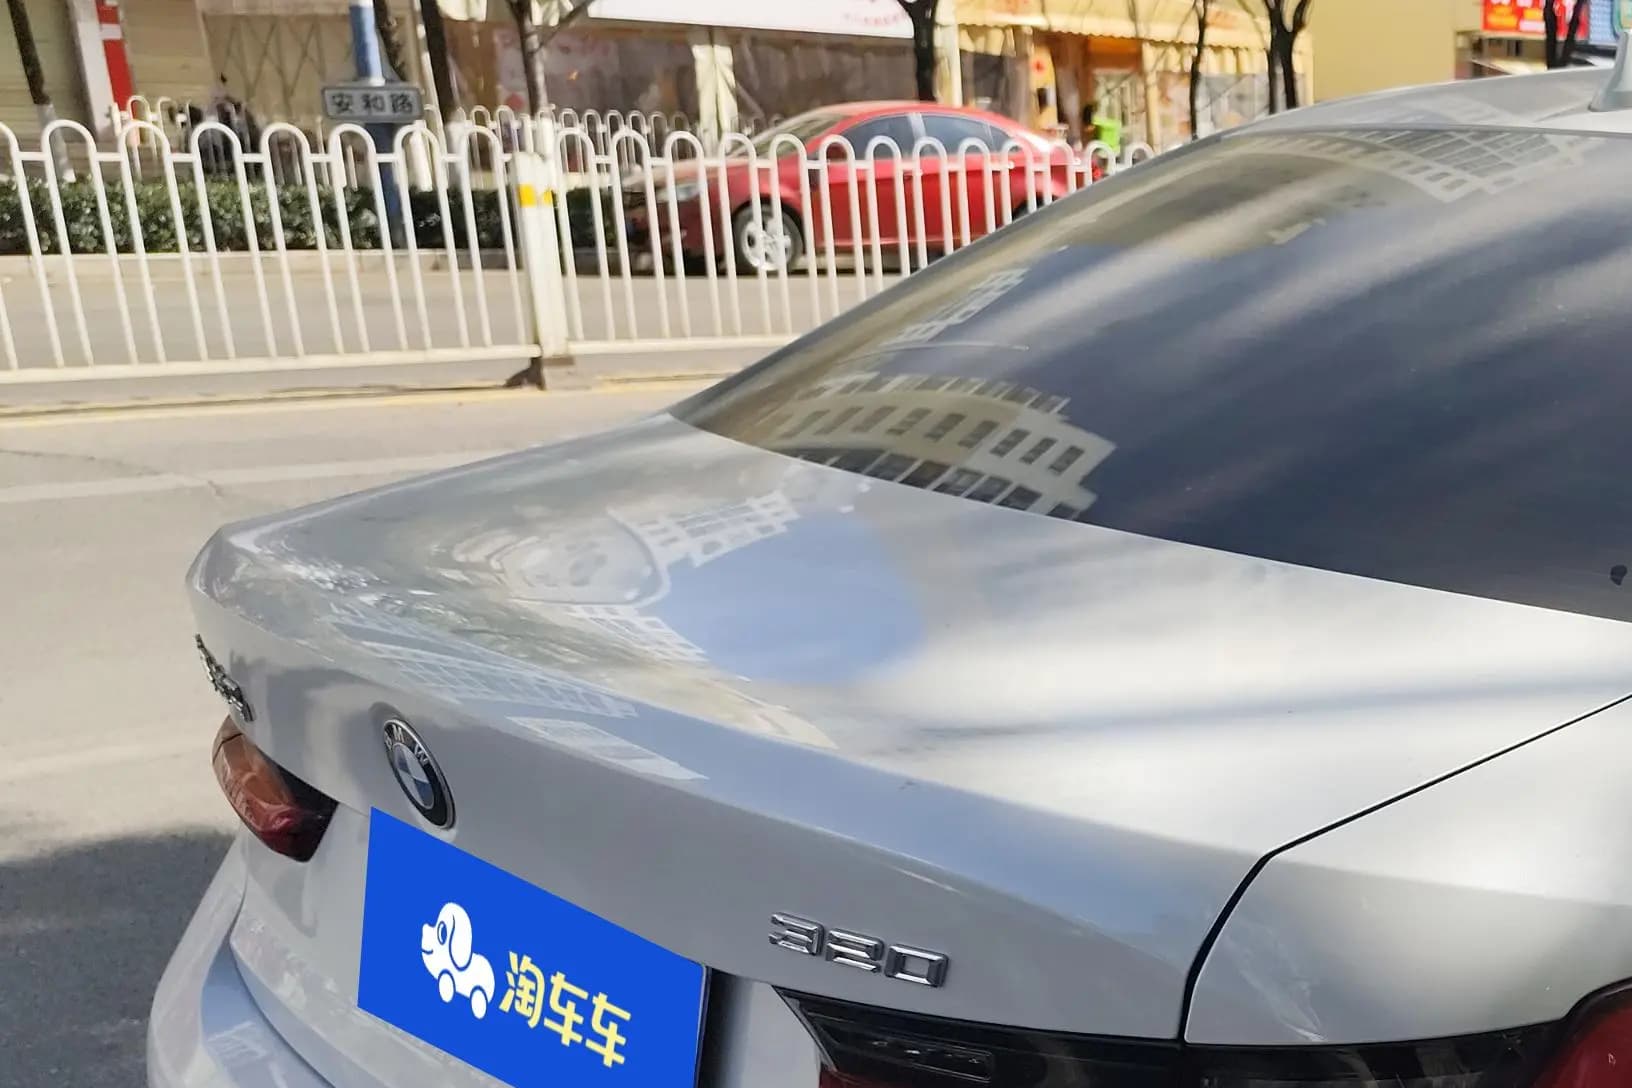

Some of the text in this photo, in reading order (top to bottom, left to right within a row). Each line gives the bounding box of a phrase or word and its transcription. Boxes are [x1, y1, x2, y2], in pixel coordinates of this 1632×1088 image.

[331, 92, 413, 114] 安和路
[384, 723, 429, 766] BMW
[767, 911, 950, 989] 320
